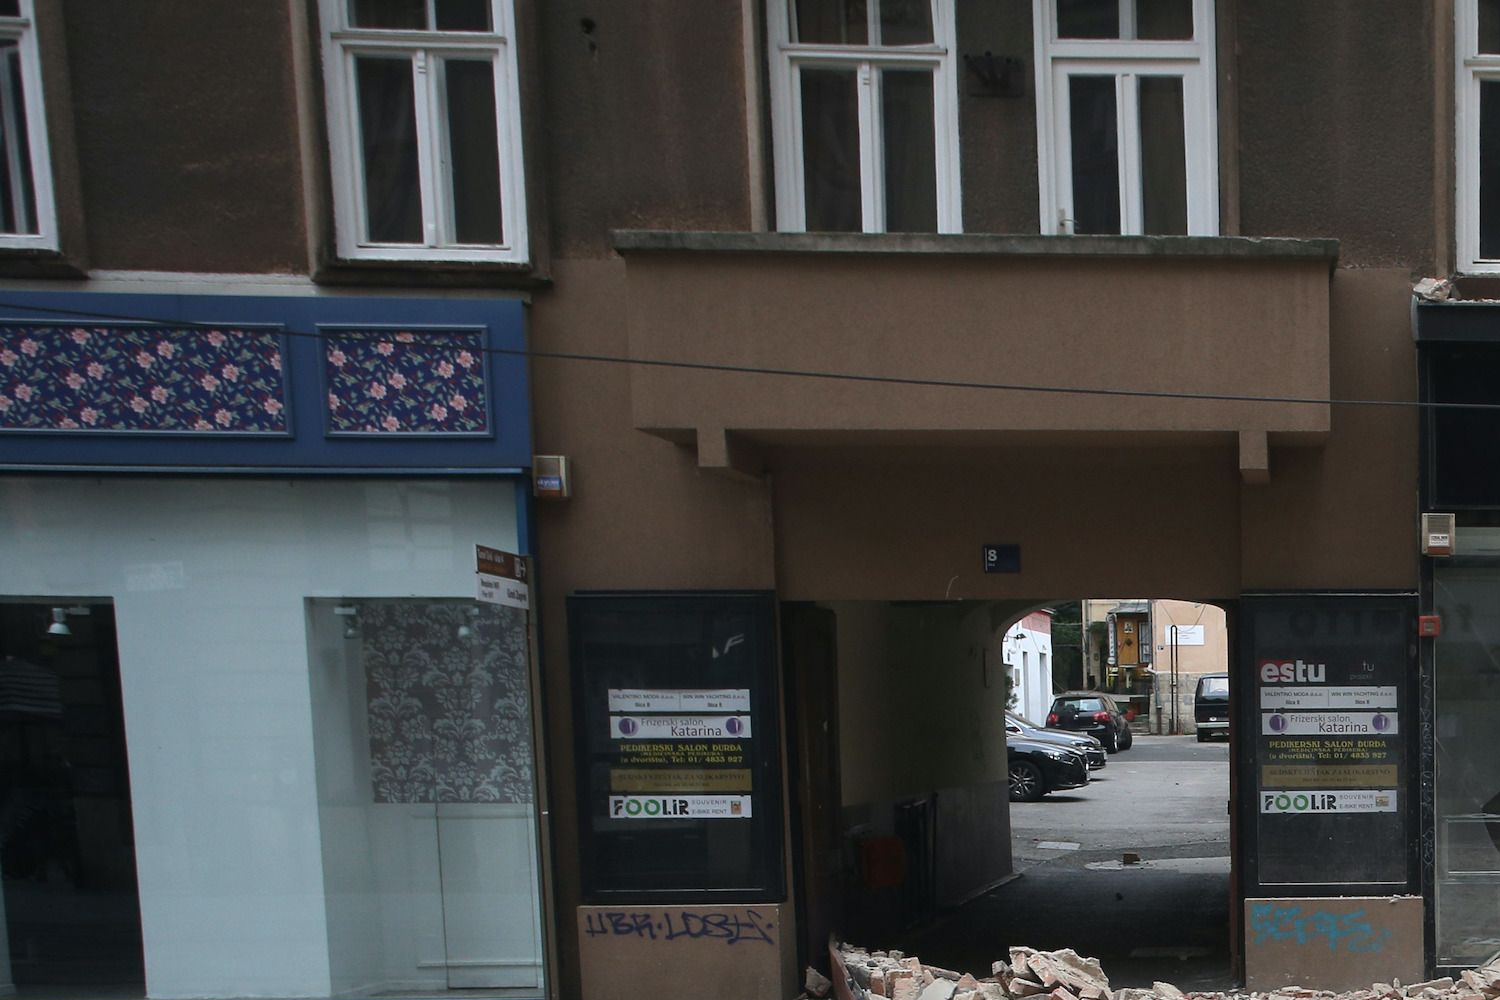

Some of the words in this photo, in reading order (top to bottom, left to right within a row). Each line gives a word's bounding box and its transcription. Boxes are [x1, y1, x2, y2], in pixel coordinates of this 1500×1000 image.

[987, 549, 998, 562] 8
[1260, 659, 1326, 683] estu
[641, 718, 677, 727] Frizerski
[679, 718, 704, 726] salon
[1290, 715, 1326, 723] Frizerski
[1327, 715, 1351, 723] salon
[671, 725, 722, 737] Katarina
[1318, 722, 1368, 733] Katarina
